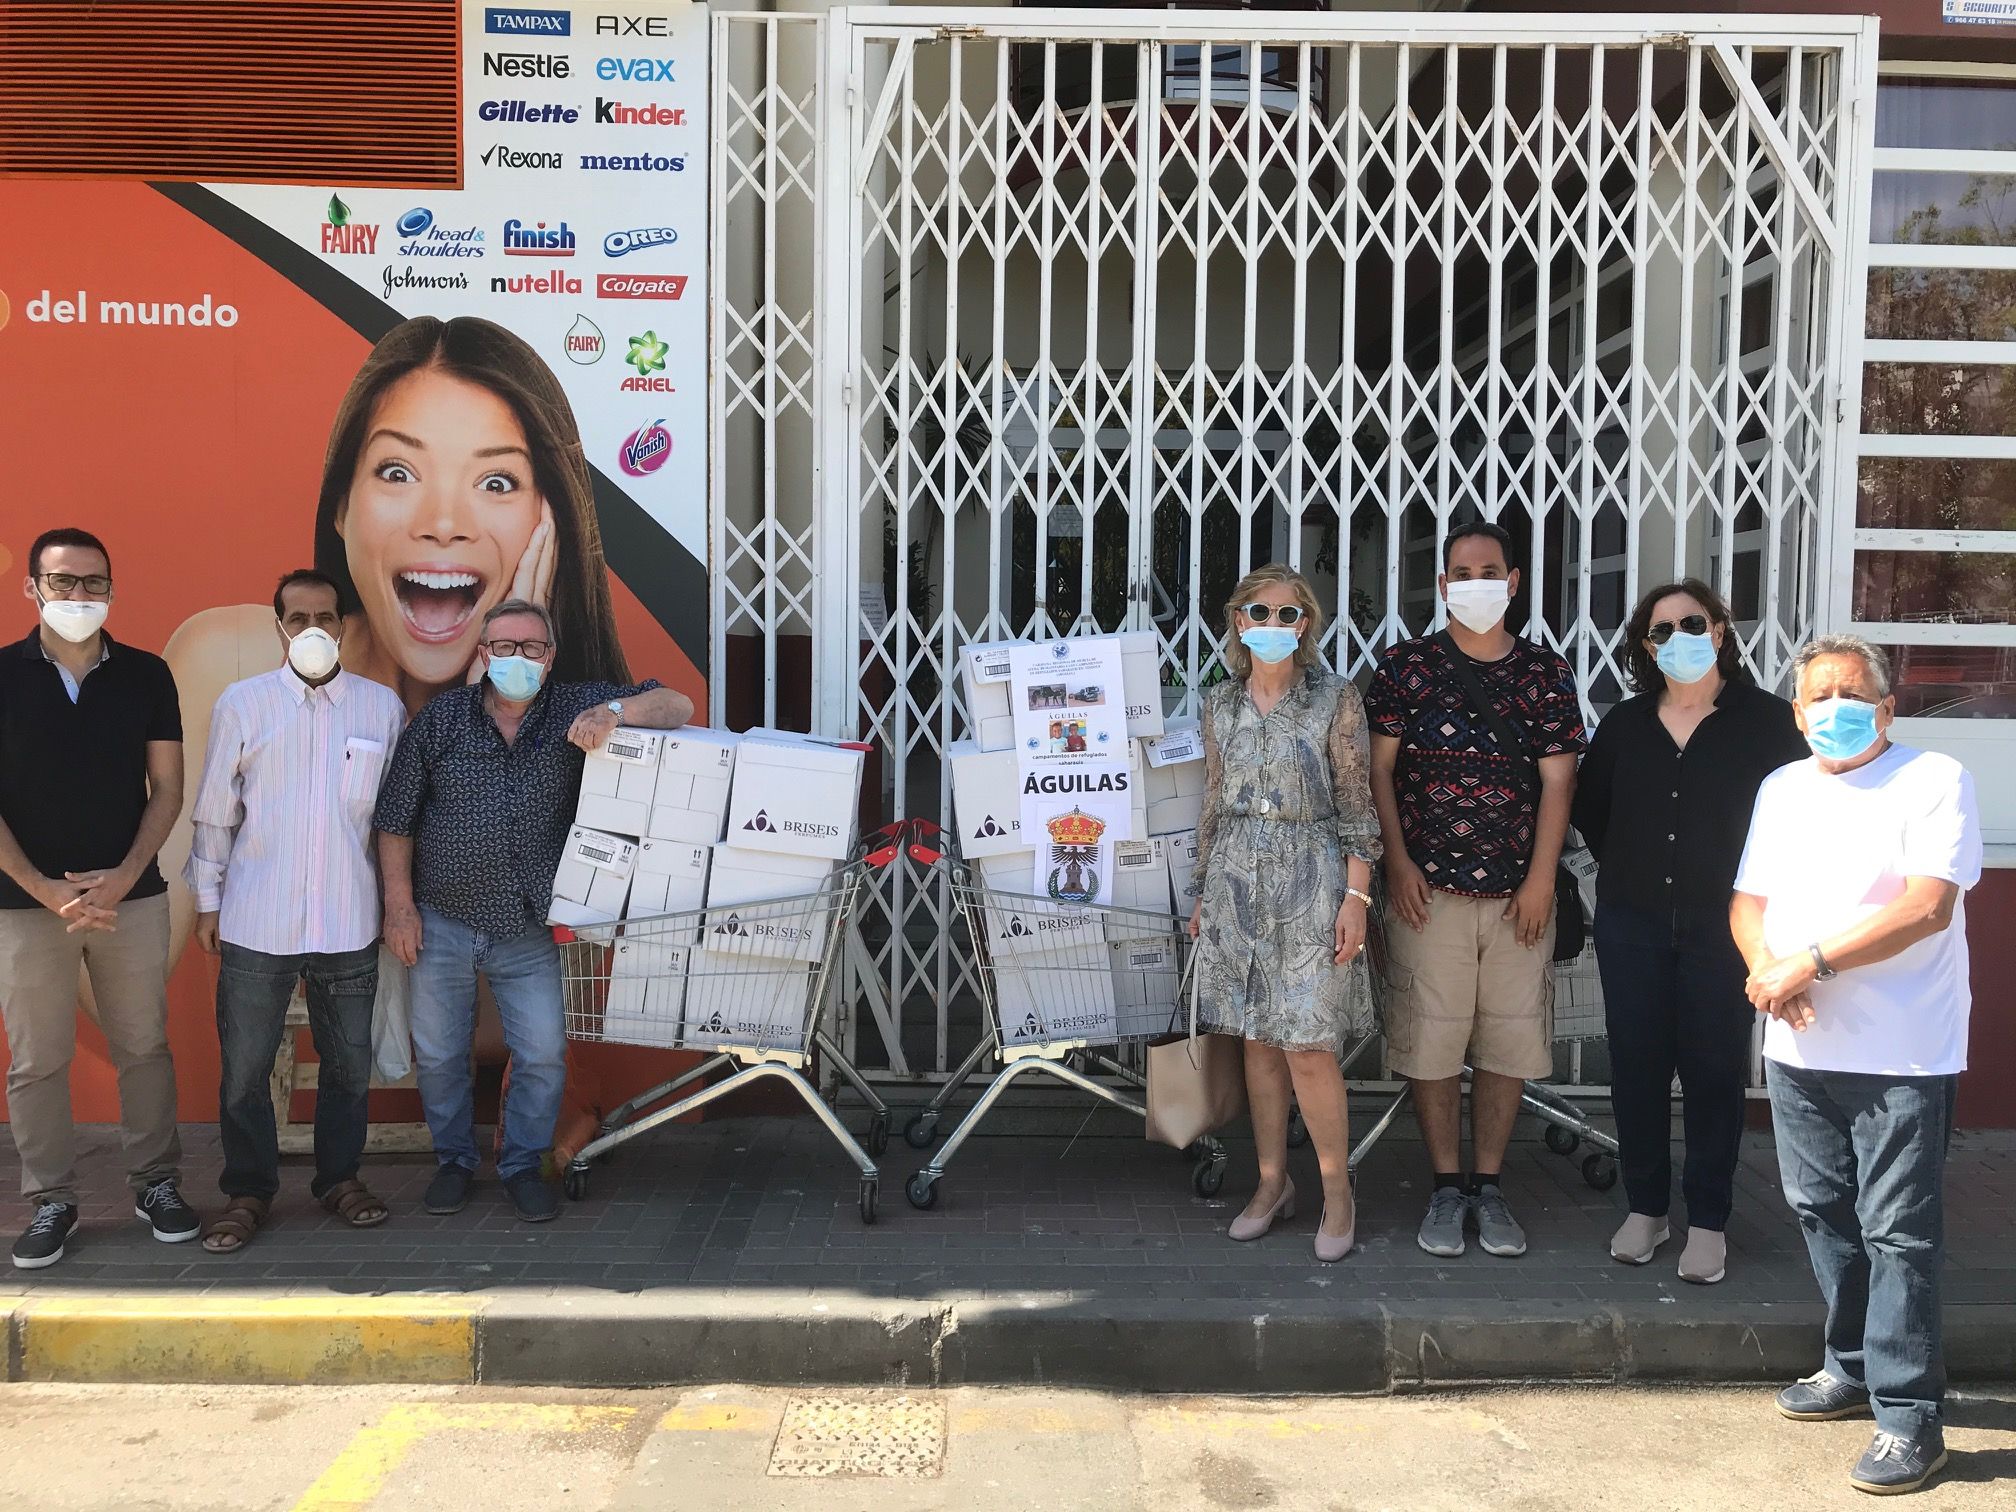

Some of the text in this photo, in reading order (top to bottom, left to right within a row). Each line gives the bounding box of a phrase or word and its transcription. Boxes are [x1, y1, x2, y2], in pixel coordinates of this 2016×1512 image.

[1963, 2, 2016, 14] SECURITY
[493, 14, 562, 30] TAMPAX
[596, 16, 668, 36] AXE
[484, 52, 570, 78] Nestlé
[596, 57, 676, 82] evax
[478, 100, 578, 124] Gillette
[498, 146, 562, 169] Rexona
[580, 152, 684, 172] mentos
[321, 222, 380, 254] FAIRY
[504, 218, 576, 248] finish
[605, 228, 678, 252] OREO
[396, 241, 486, 258] shoulders
[382, 264, 470, 299] Johnson's
[490, 270, 582, 294] nutella
[602, 277, 677, 296] Colgate
[26, 290, 239, 327] del mundo
[568, 336, 601, 352] FAIRY
[620, 377, 676, 392] ARIEL
[626, 430, 668, 468] Vanish
[1024, 772, 1128, 794] ÁGUILAS
[783, 820, 839, 836] BRISEIS
[1038, 915, 1090, 930] BRISEIS
